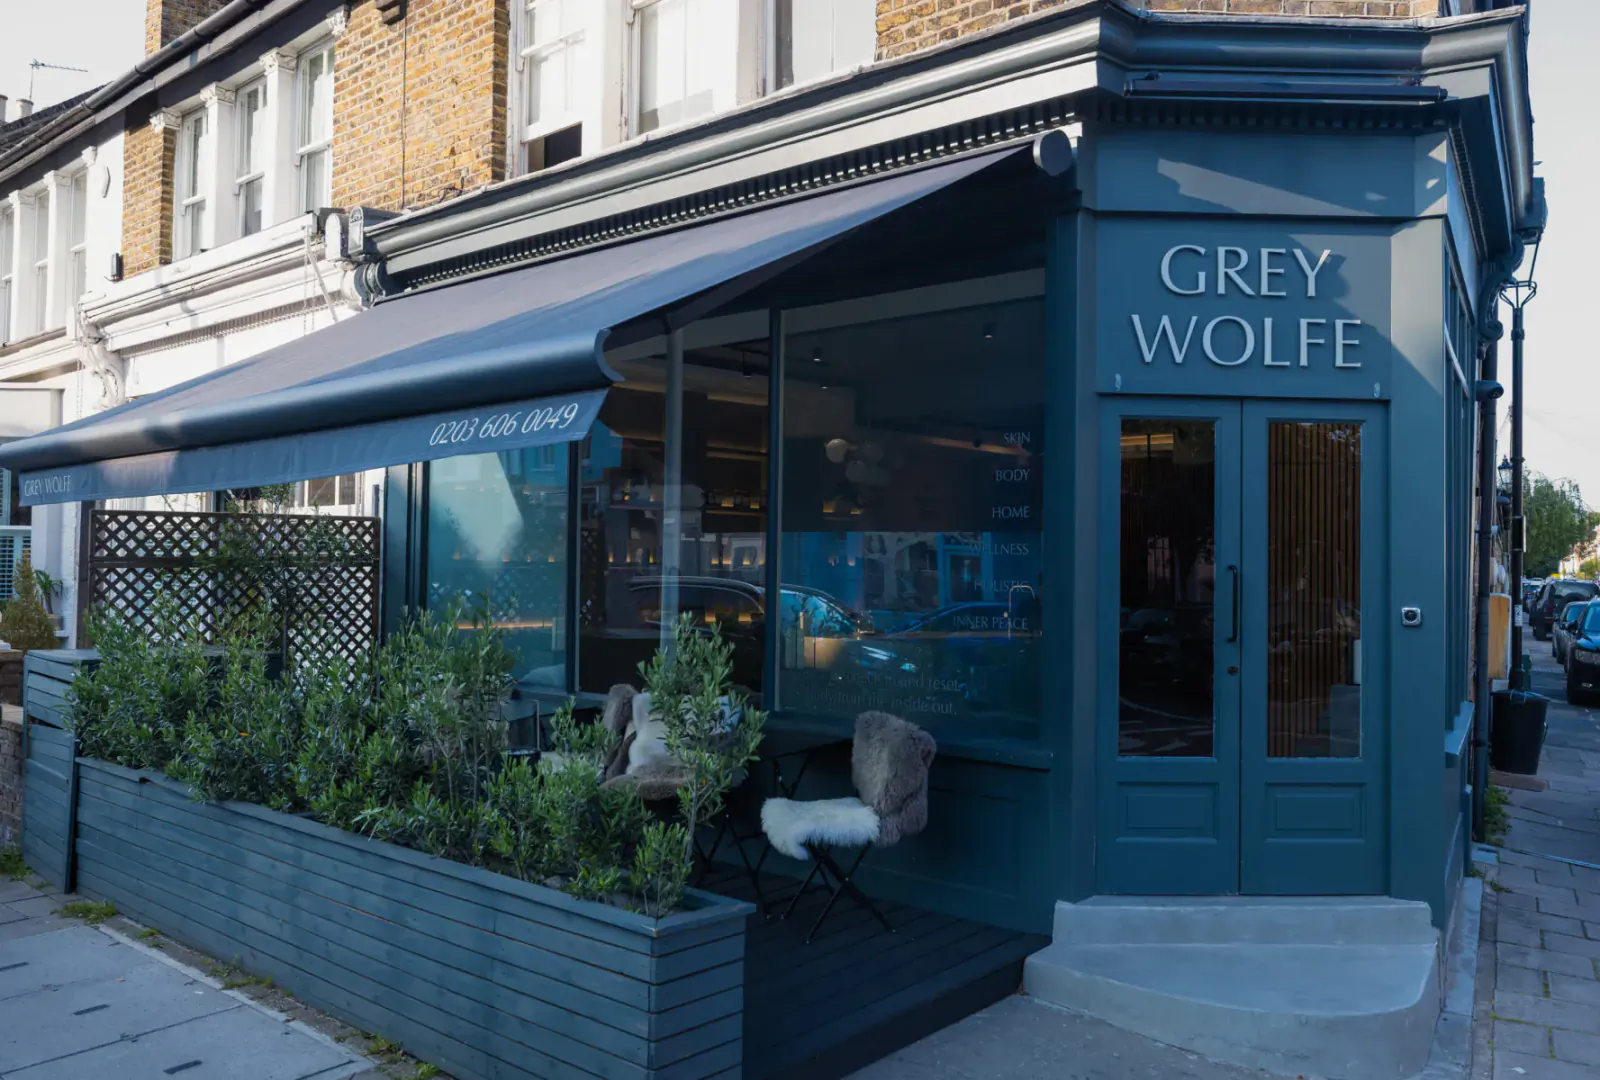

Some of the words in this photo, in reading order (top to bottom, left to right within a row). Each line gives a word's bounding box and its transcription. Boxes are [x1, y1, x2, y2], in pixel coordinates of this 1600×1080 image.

[1160, 244, 1331, 297] GREY
[1131, 314, 1362, 368] WOLFE
[429, 417, 479, 446] 0203
[478, 411, 522, 438] 606
[521, 402, 579, 434] 0049
[1003, 431, 1031, 445] SKIN
[995, 468, 1030, 482] BODY
[24, 479, 42, 496] GREY
[992, 505, 1030, 519] HOME
[953, 614, 989, 630] INNER
[992, 615, 1028, 631] PEACE
